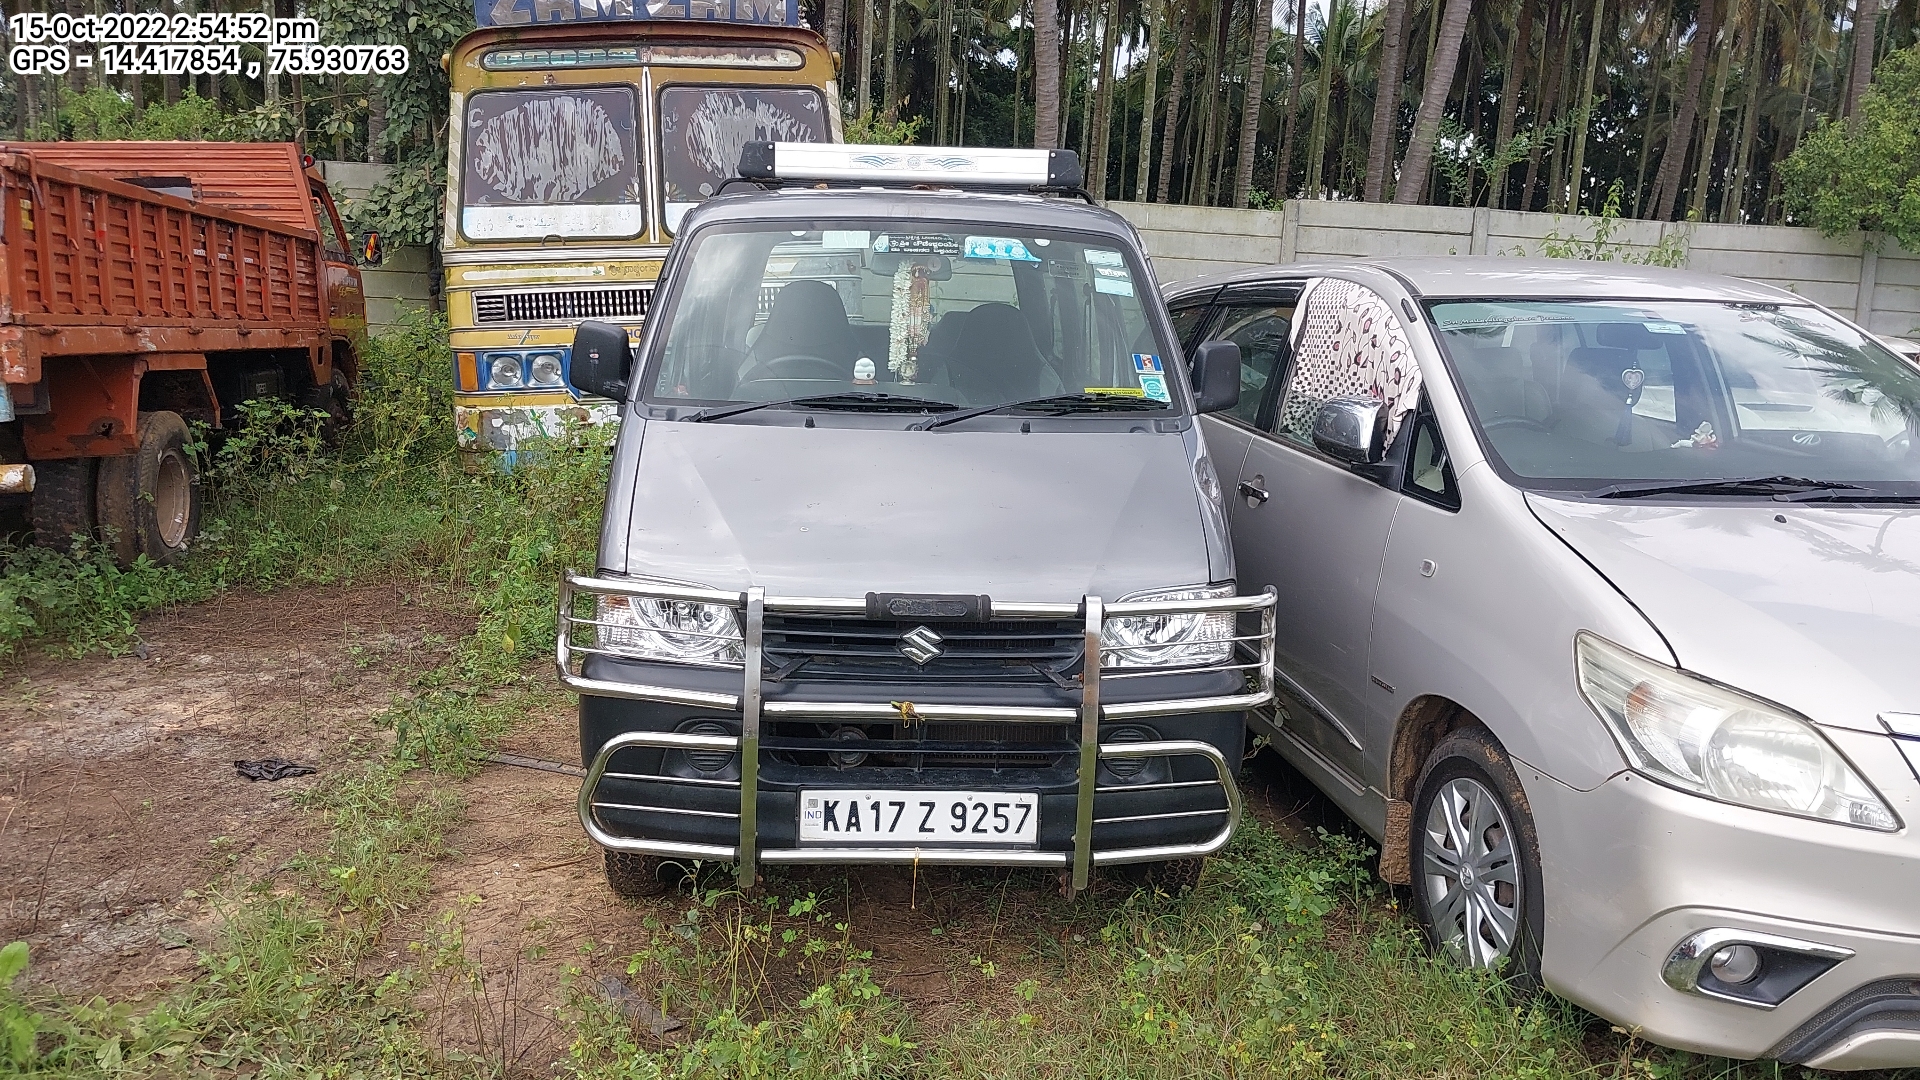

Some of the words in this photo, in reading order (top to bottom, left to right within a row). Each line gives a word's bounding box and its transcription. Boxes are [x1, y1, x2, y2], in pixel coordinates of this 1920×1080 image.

[804, 810, 822, 819] IND
[823, 800, 906, 833] KA17
[918, 801, 936, 834] Z
[950, 802, 1032, 834] 9257
